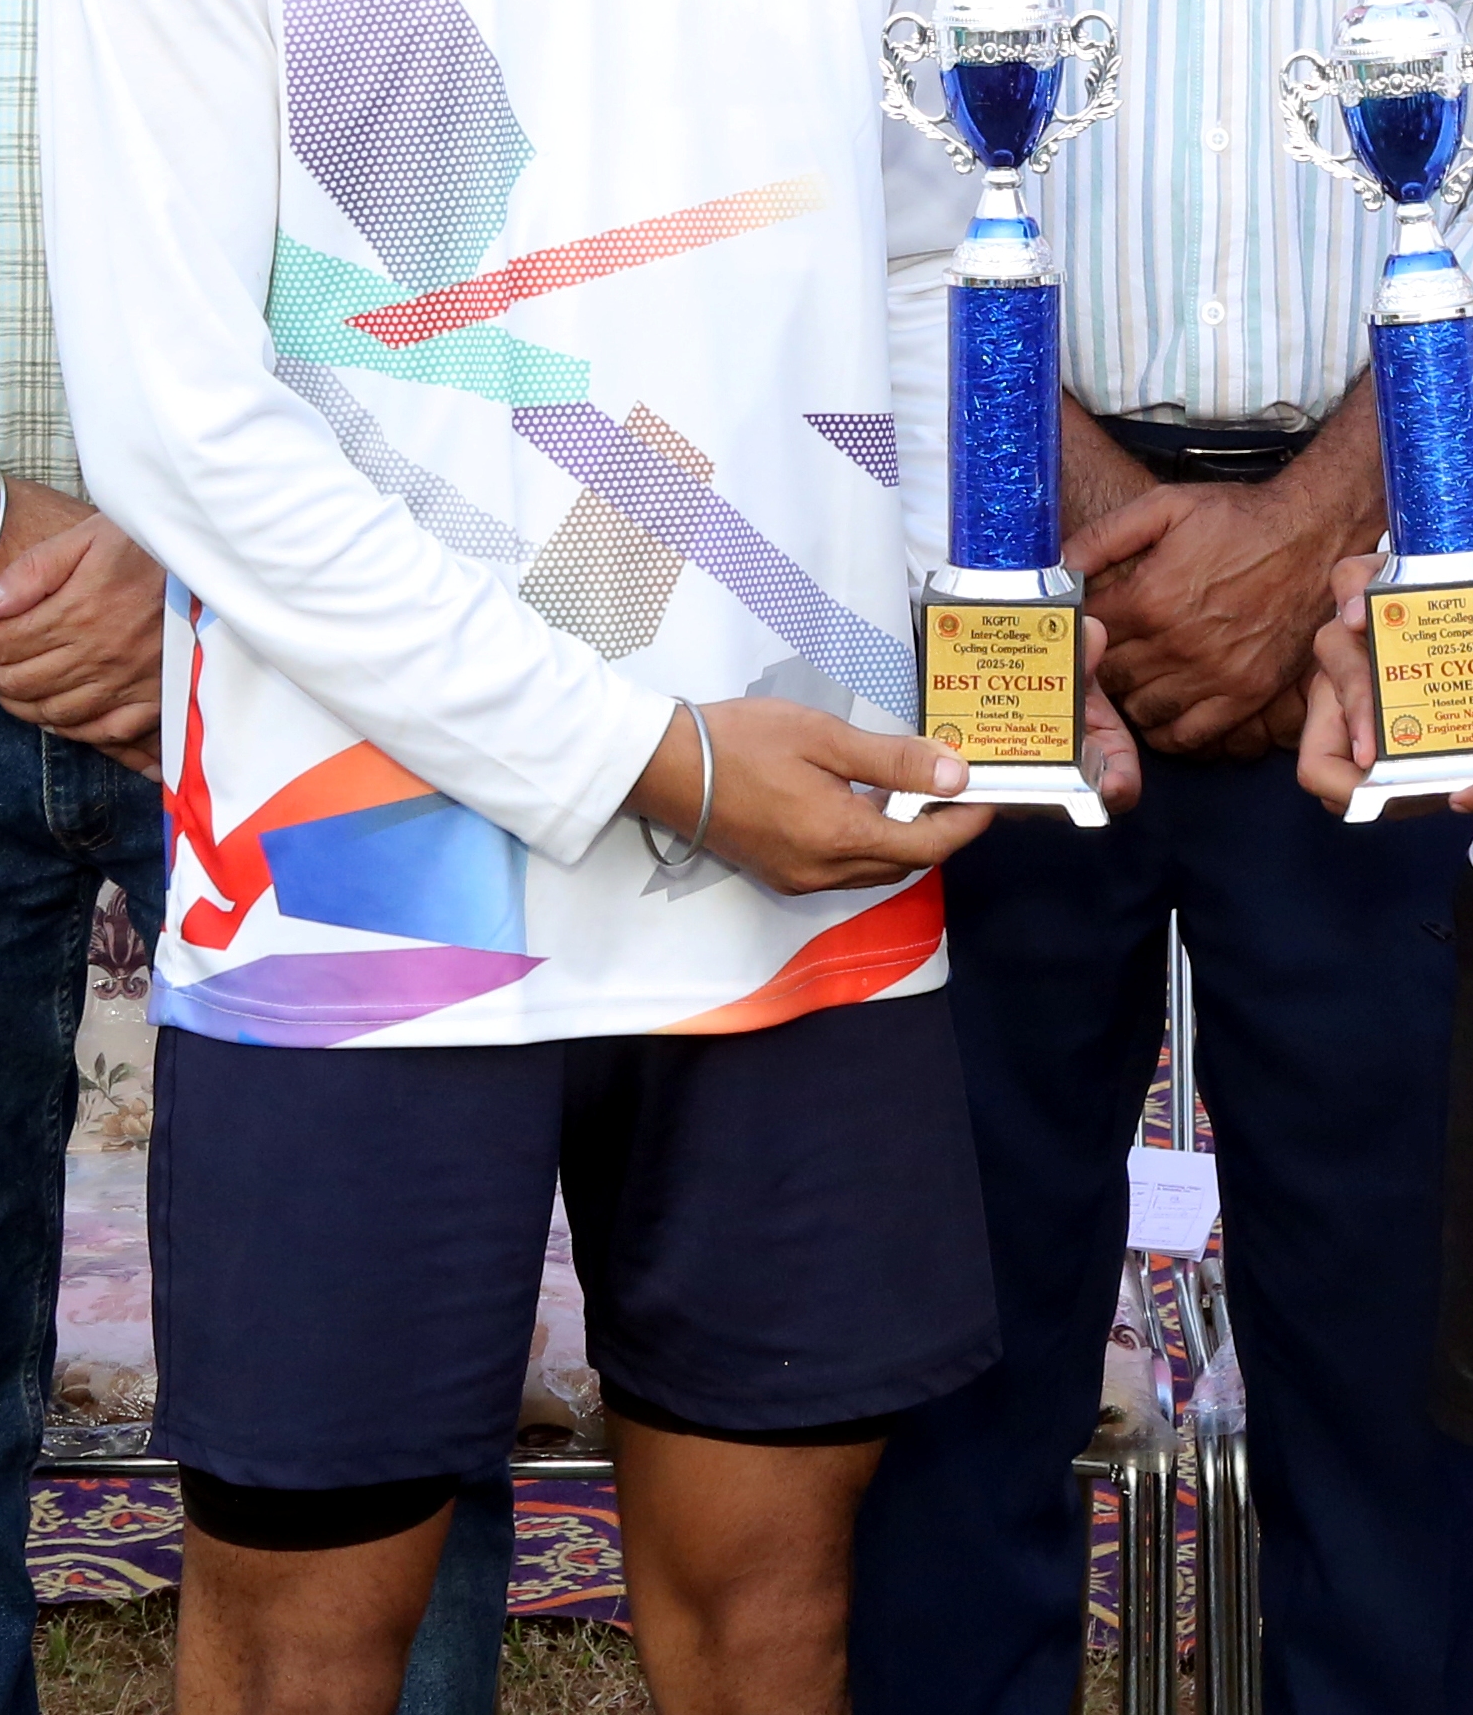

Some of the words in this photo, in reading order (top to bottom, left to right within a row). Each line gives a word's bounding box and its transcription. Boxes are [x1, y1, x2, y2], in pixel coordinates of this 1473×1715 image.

[1427, 598, 1466, 611] IKGPTU
[981, 616, 1021, 626] IKGPTU
[971, 629, 1031, 642] Inter-College
[1401, 629, 1437, 644] Cycling
[953, 643, 987, 655] Cycling
[990, 643, 1048, 655] Competition
[976, 659, 1025, 670] (2025-26)
[1385, 662, 1434, 682] BEST
[933, 675, 981, 690] BEST
[987, 675, 1068, 691] CYCLIST
[980, 695, 1020, 707] (MEN)
[1432, 696, 1466, 707] Hosted
[975, 710, 1009, 719] Hosted
[1011, 711, 1024, 720] By
[1434, 709, 1461, 721] Guru
[1005, 723, 1038, 733] Nanak
[1040, 723, 1060, 733] Dev
[967, 734, 1027, 745] Engineering
[1030, 735, 1069, 747] College
[994, 747, 1041, 756] Ludhiana
